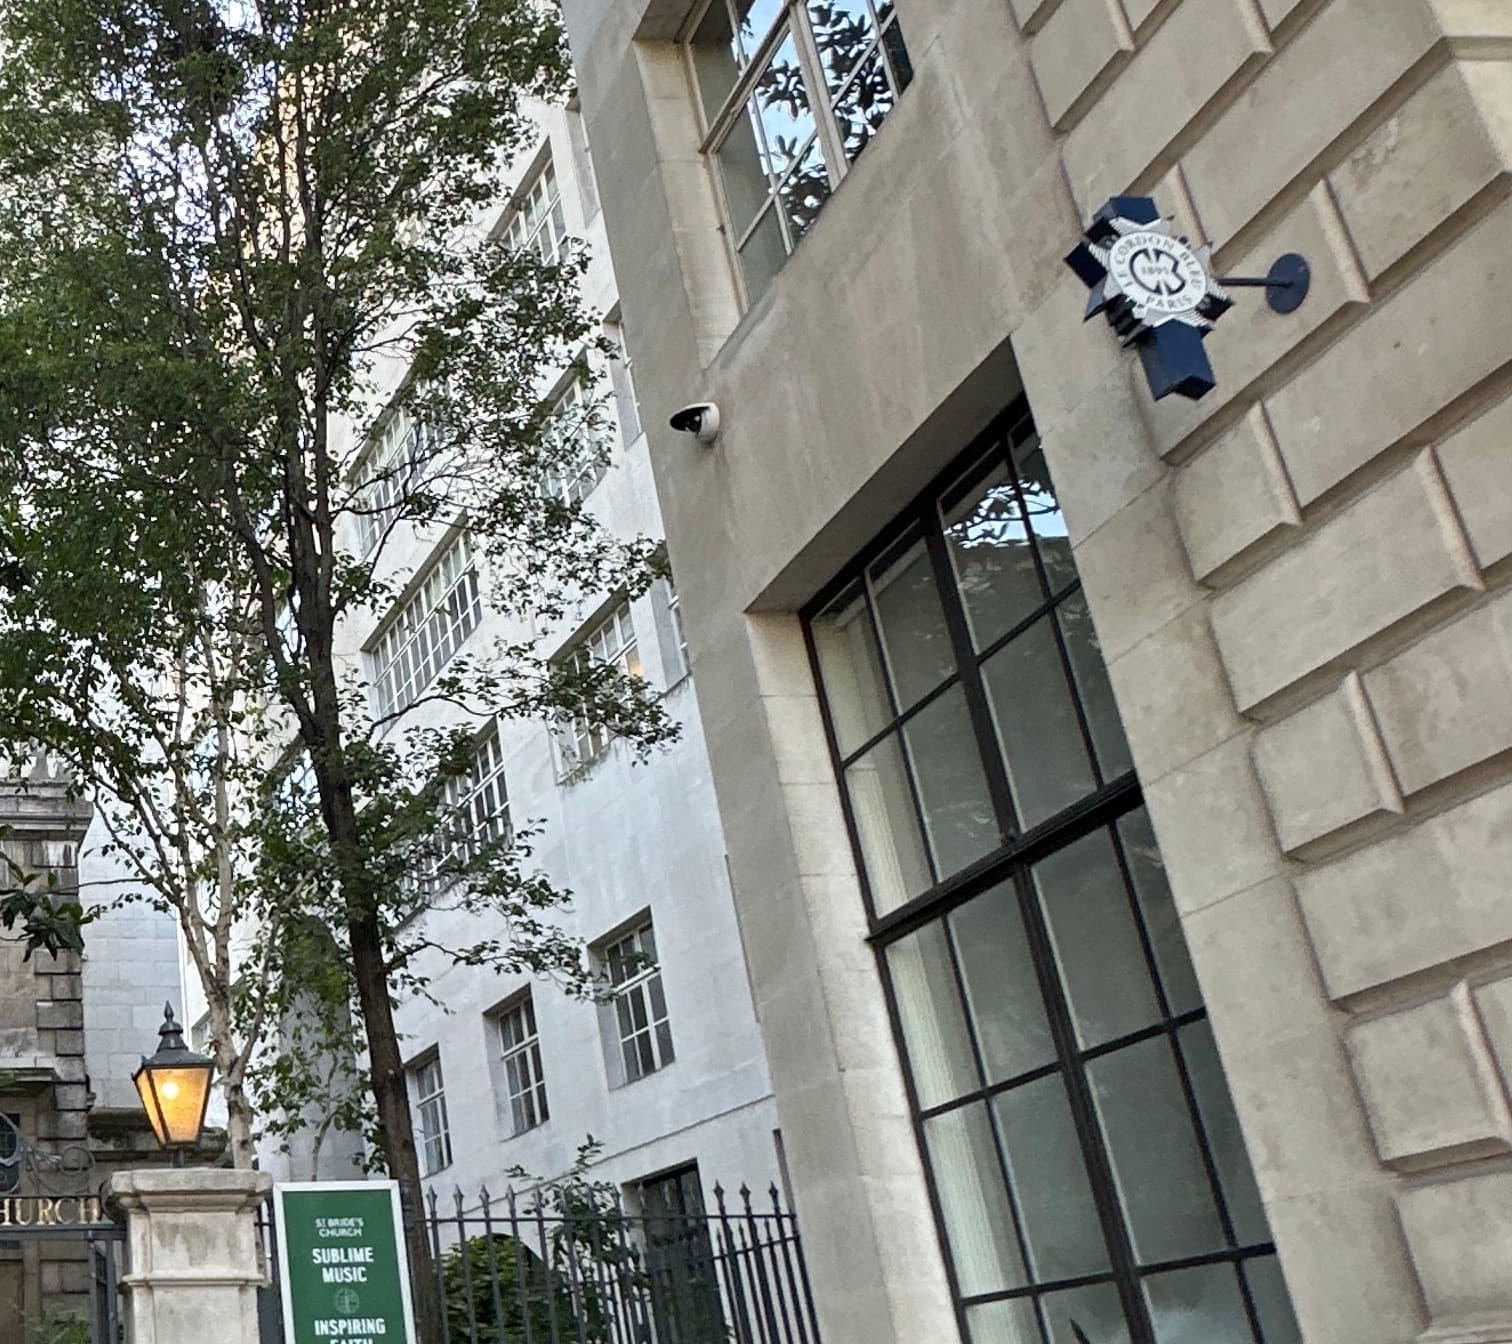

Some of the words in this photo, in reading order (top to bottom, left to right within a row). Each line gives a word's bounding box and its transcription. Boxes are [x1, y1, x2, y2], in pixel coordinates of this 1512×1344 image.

[1145, 294, 1193, 309] PARIS
[318, 1227, 363, 1238] CHURCH
[312, 1247, 375, 1264] SUBLIME
[322, 1266, 368, 1283] MUSIC
[314, 1318, 387, 1336] INSPIRING
